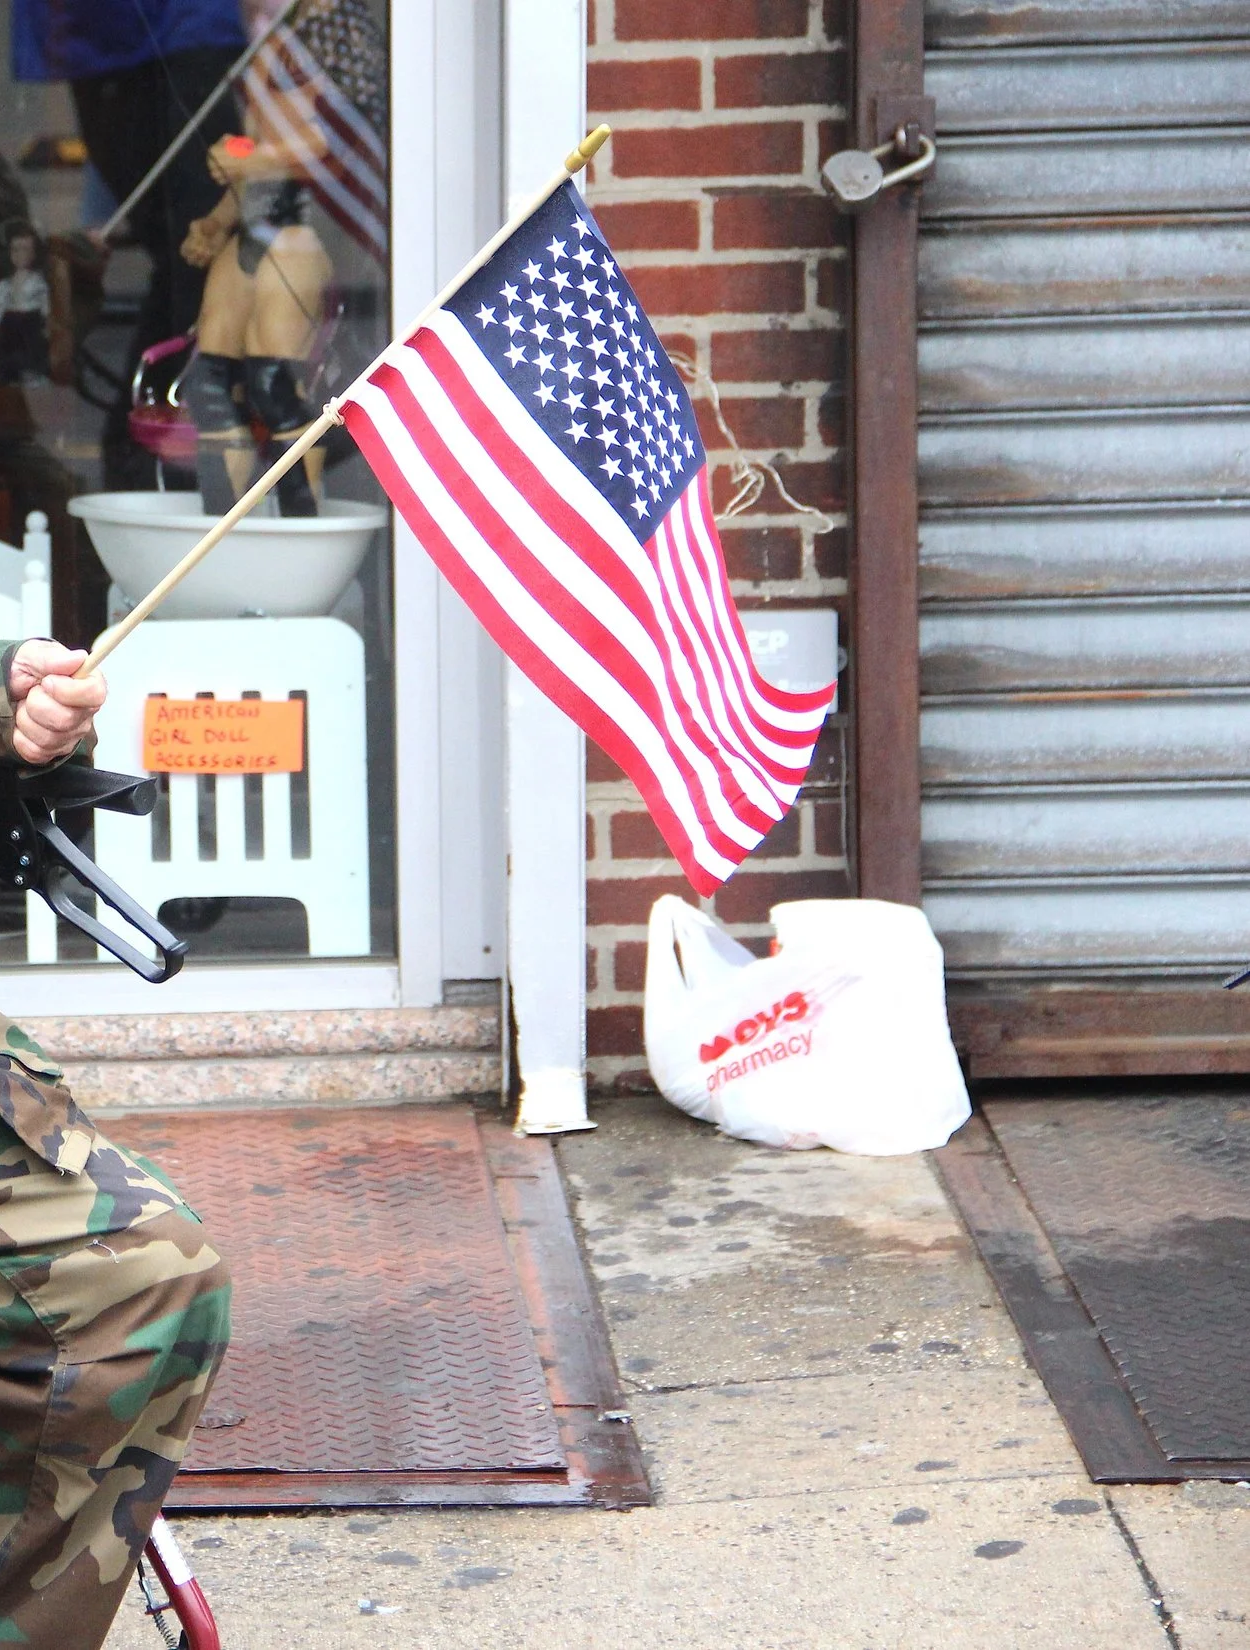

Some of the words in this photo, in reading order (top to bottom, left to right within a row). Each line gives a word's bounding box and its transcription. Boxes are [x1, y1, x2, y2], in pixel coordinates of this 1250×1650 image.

[148, 728, 192, 746] GIRL
[204, 729, 250, 745] DOLL
[154, 752, 278, 769] ACCESSORIES
[706, 1028, 814, 1093] pharmacy
